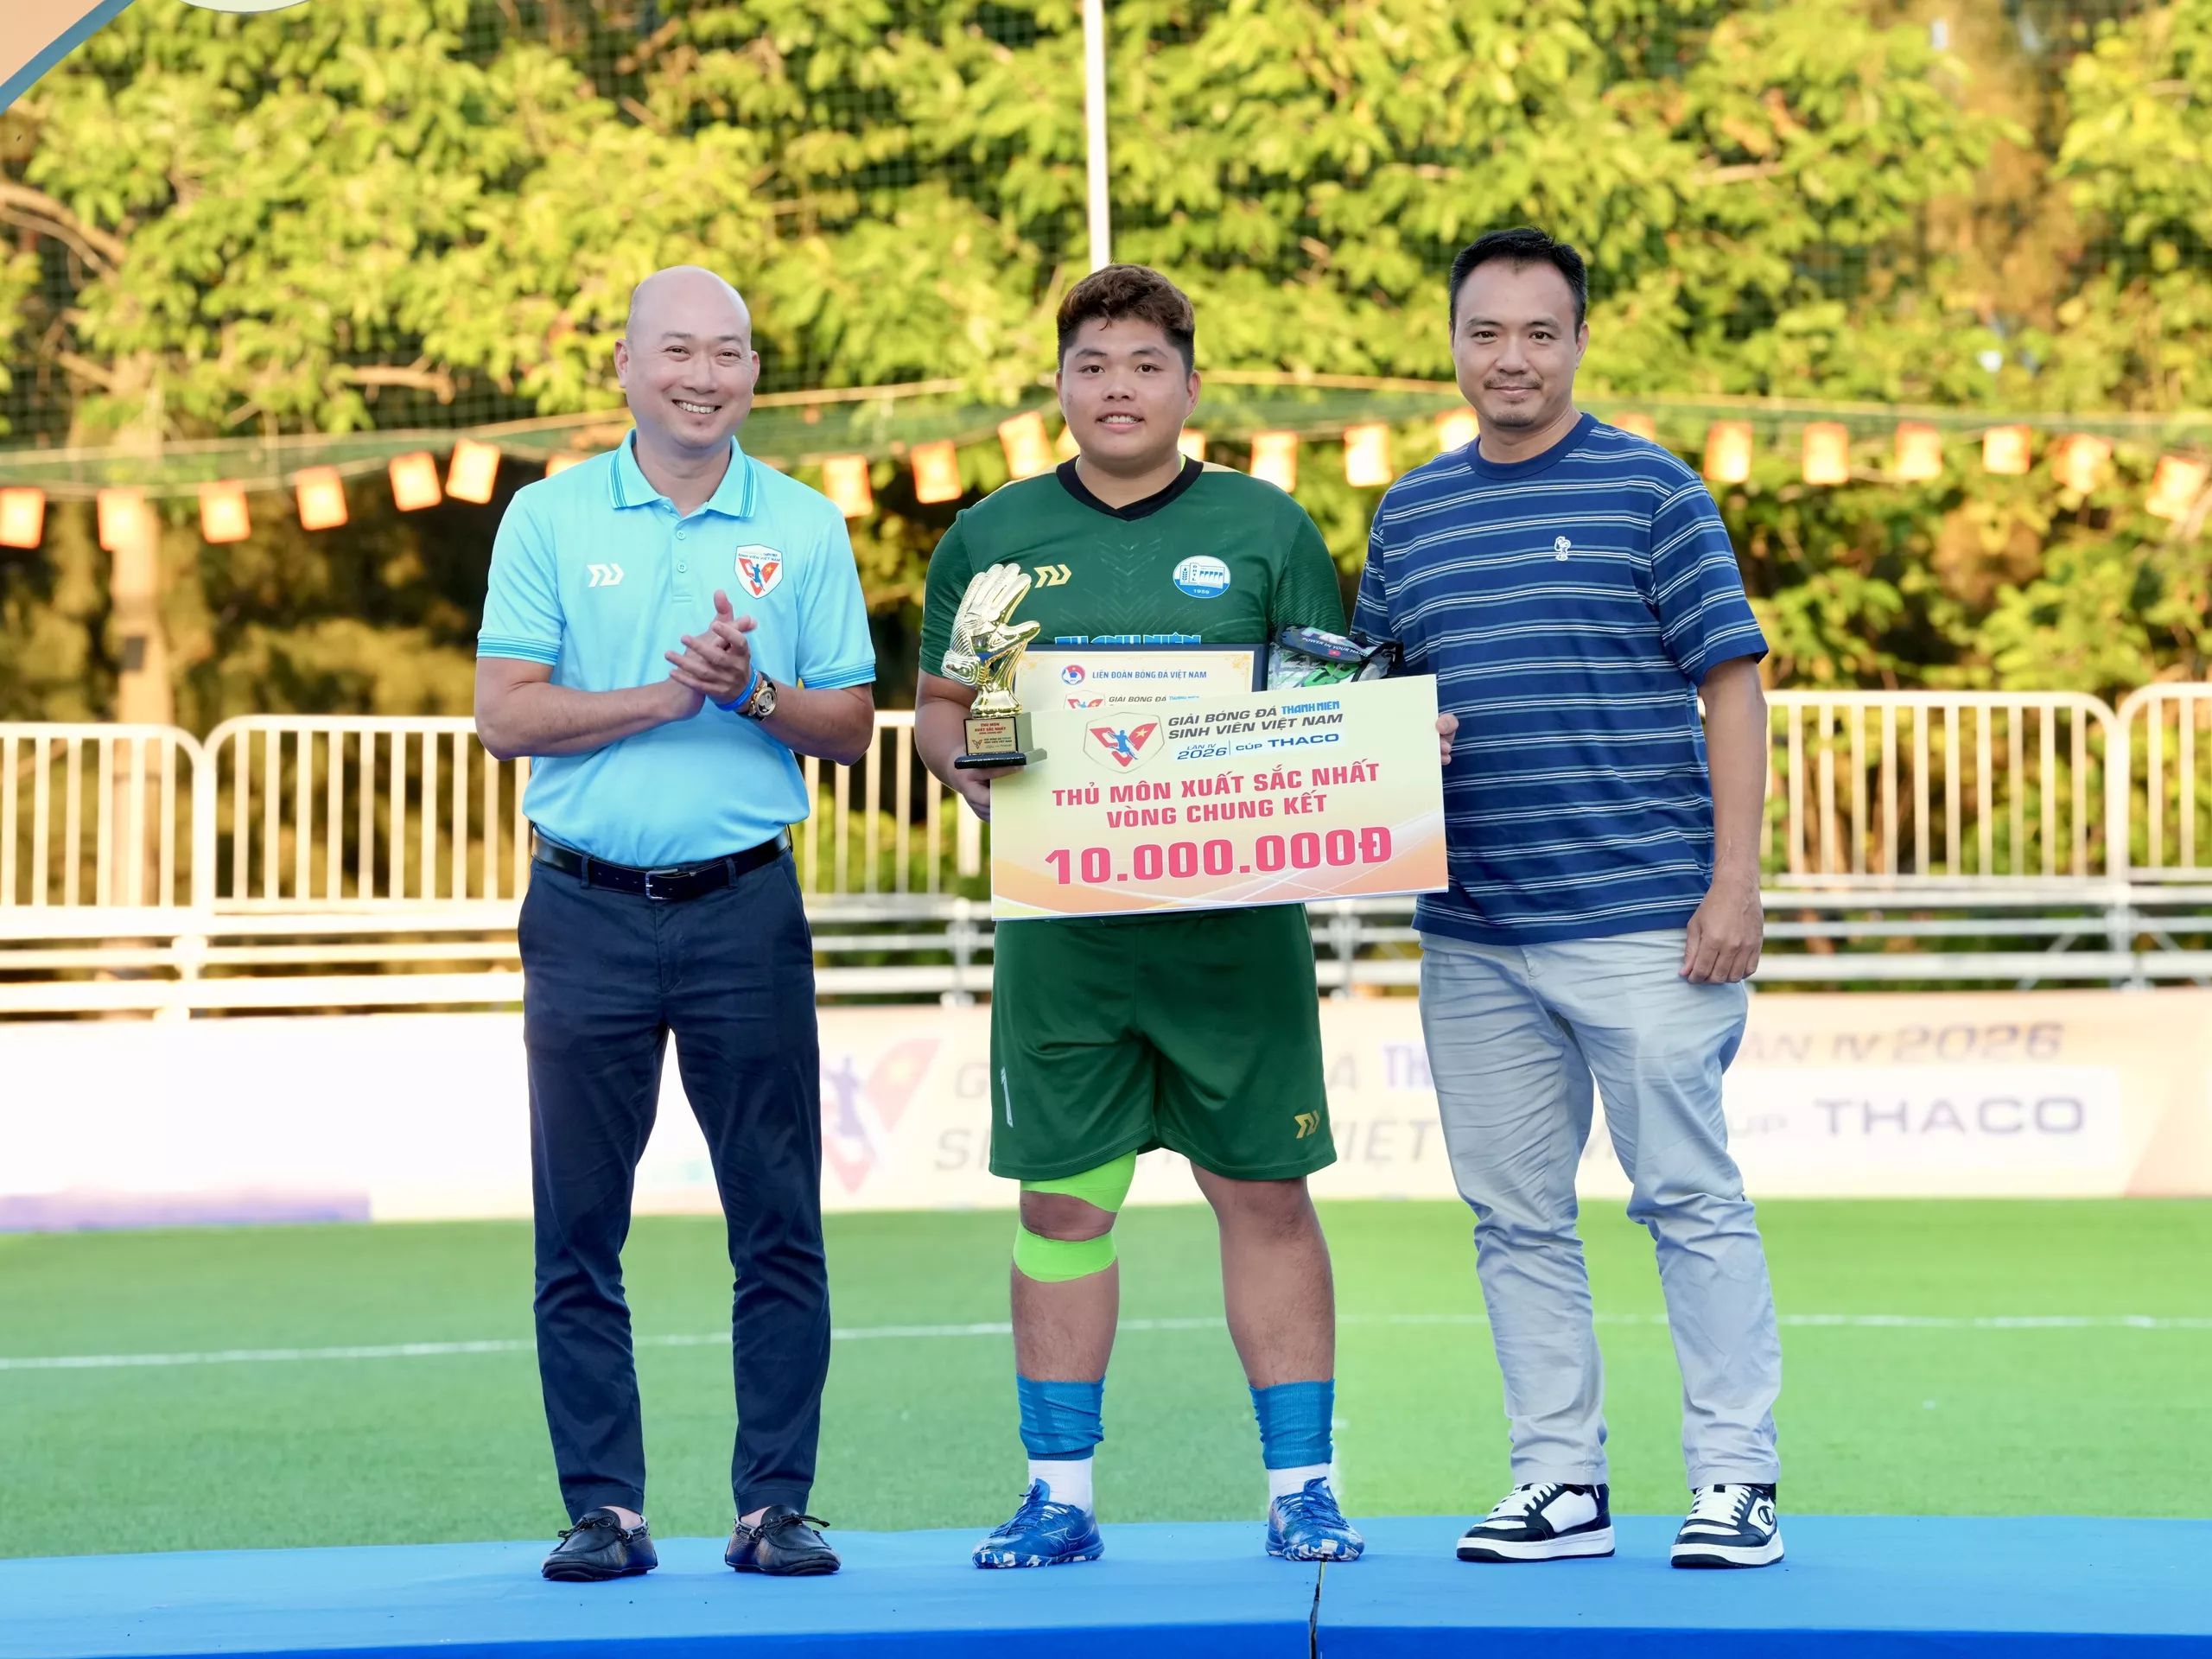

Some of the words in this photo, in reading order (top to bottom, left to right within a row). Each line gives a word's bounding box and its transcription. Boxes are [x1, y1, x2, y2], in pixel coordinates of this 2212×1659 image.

[1301, 637, 1324, 645] POWER
[1332, 644, 1350, 652] YOUR
[1092, 669, 1109, 679] LIÊN
[1135, 669, 1156, 679] BÓNG
[1170, 669, 1187, 680] VIỆT
[1168, 713, 1199, 726] GIẢI
[1205, 710, 1250, 723] BÓNG
[1255, 705, 1277, 718] ĐÁ
[1281, 702, 1315, 715] THANH
[1168, 727, 1210, 739] SINH
[1216, 721, 1255, 734] VIÊN
[1262, 717, 1297, 731] VIỆT
[1302, 714, 1343, 727] NAM
[1177, 747, 1227, 760] 2026
[1236, 742, 1262, 751] CÚP
[1268, 733, 1339, 748] THACO
[1052, 781, 1099, 806] THỦ
[1109, 780, 1171, 804] MÔN
[1181, 770, 1244, 798] XUẤT
[1253, 764, 1302, 791] SẮC
[1312, 758, 1380, 787] NHẤT
[1106, 805, 1177, 829] VÒNG
[1186, 799, 1274, 823] CHUNG
[1284, 789, 1327, 815] KẾT
[1045, 826, 1392, 885] 10.000.000Đ
[1891, 1021, 2067, 1064] 2026
[1815, 1096, 2085, 1137] THACO
